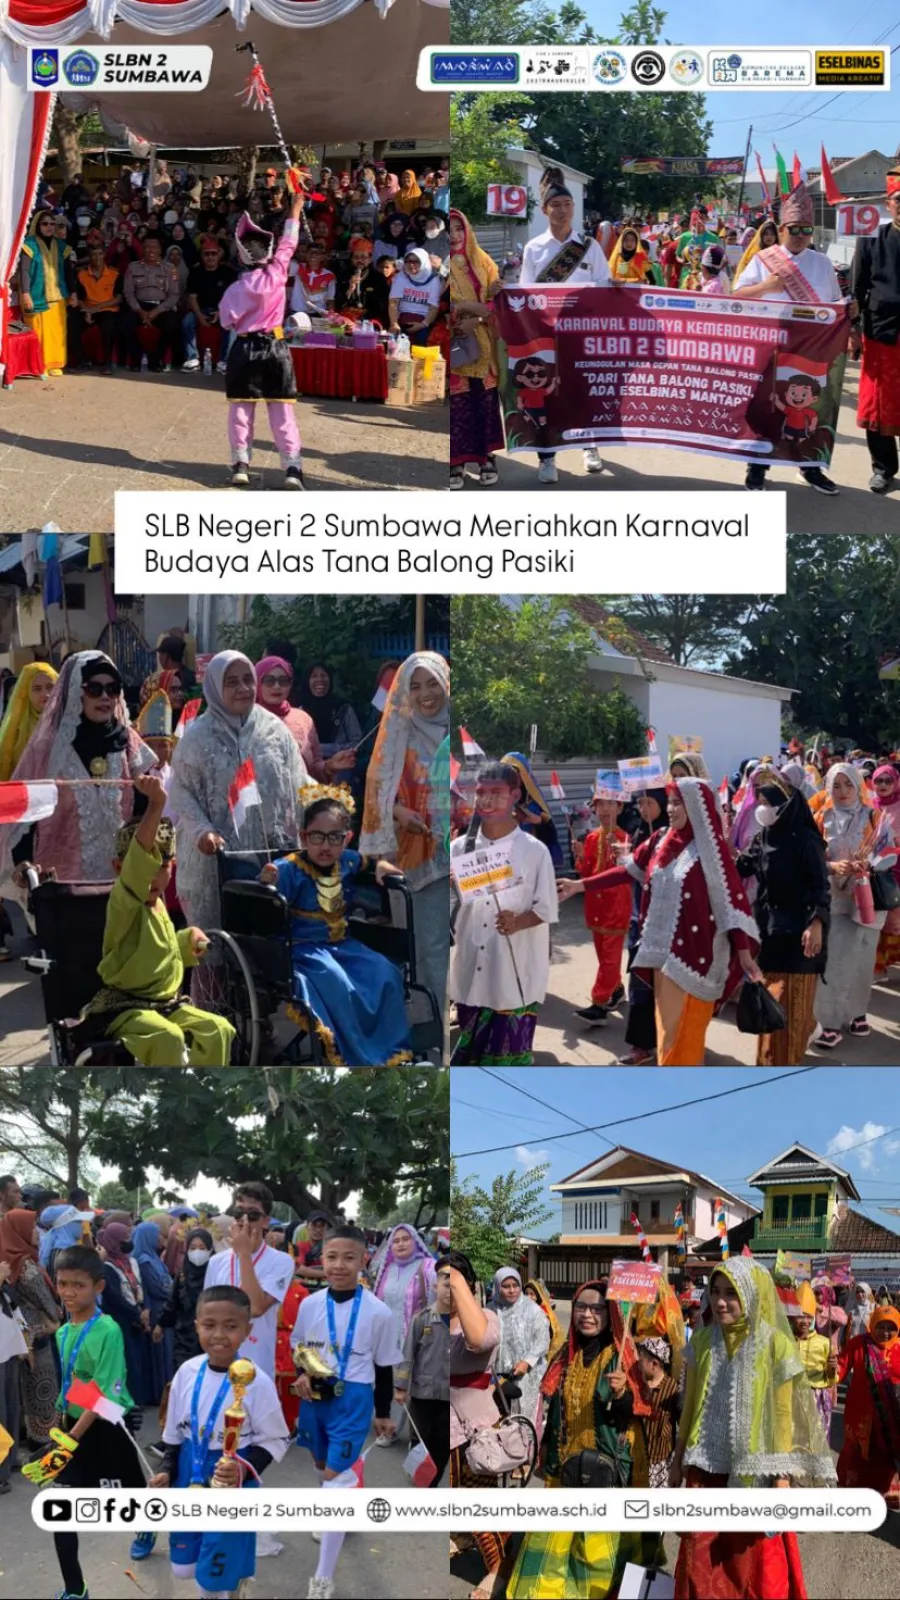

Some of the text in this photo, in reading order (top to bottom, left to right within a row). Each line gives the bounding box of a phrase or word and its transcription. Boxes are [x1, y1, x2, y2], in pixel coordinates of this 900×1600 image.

[488, 185, 527, 215] 19
[839, 204, 880, 236] 19
[554, 317, 789, 345] KARNAVAL BUDAYA KEMERDEKAAN
[584, 337, 756, 365] SLBN 2 SUMBAWA
[574, 360, 626, 369] KEUNGGULAN
[628, 361, 651, 369] MASA
[652, 362, 679, 370] DEPAN
[681, 363, 702, 372] TANA
[704, 366, 737, 378] BALONG
[622, 373, 655, 385] TANA
[659, 374, 709, 389] BALONG
[588, 386, 616, 397] ADA
[620, 386, 687, 400] ESELBINAS
[613, 1276, 654, 1288] ESELBINAS
[210, 1552, 227, 1577] 5
